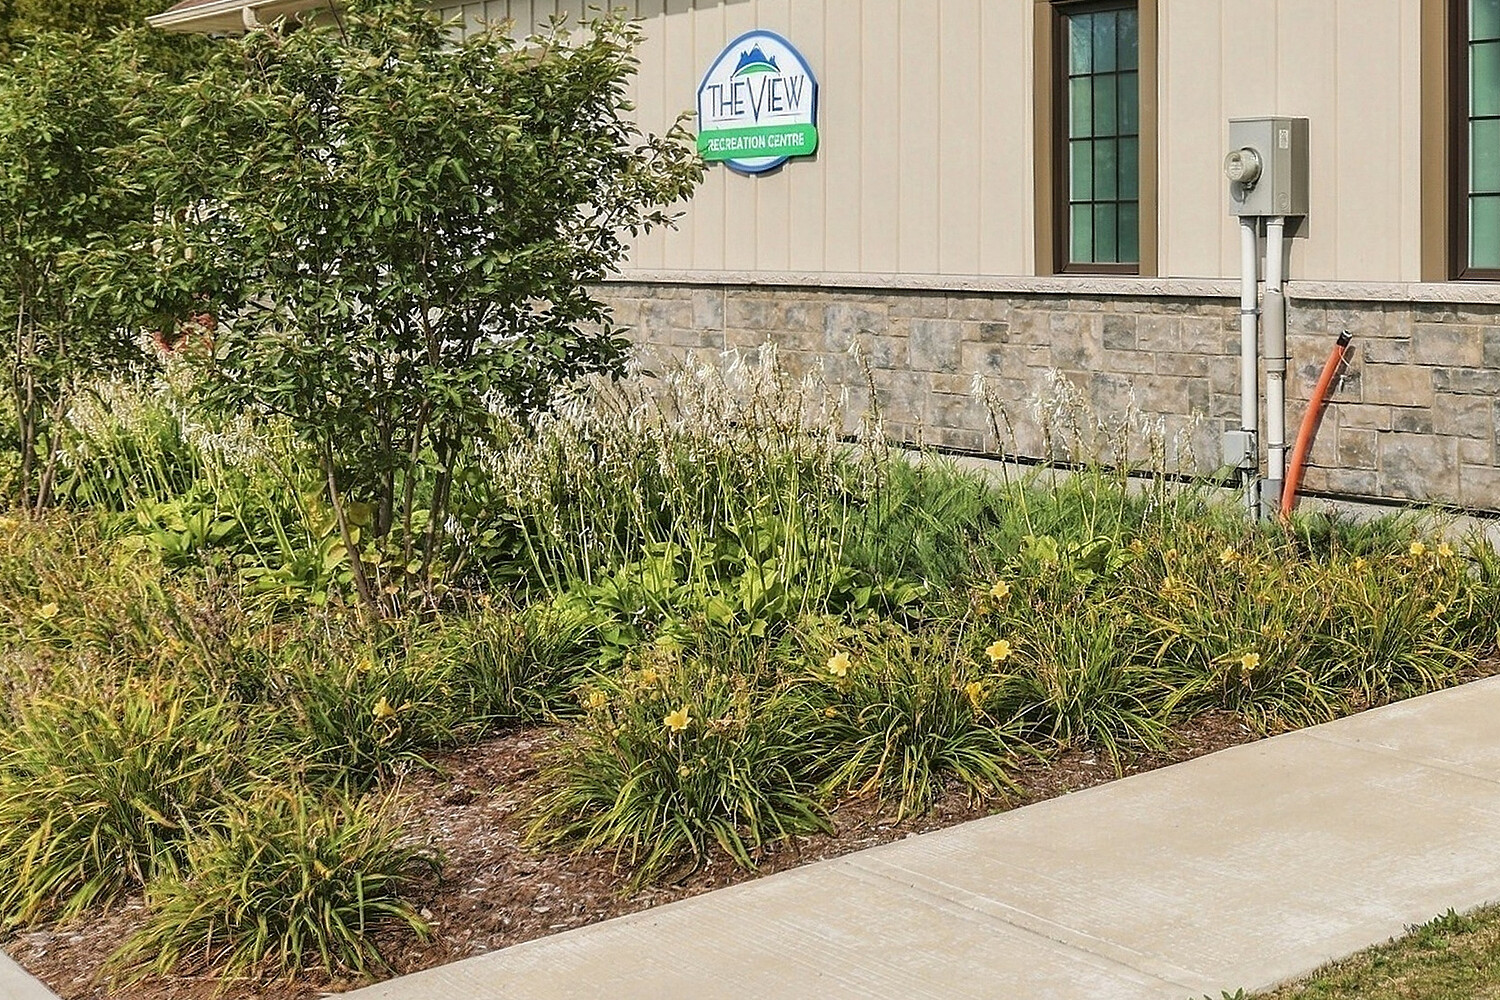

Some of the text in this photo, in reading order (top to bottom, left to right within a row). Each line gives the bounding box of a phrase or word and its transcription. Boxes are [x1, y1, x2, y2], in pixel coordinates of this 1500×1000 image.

[707, 74, 804, 123] THE VIEW
[708, 133, 804, 151] RECREATION CENTRE
